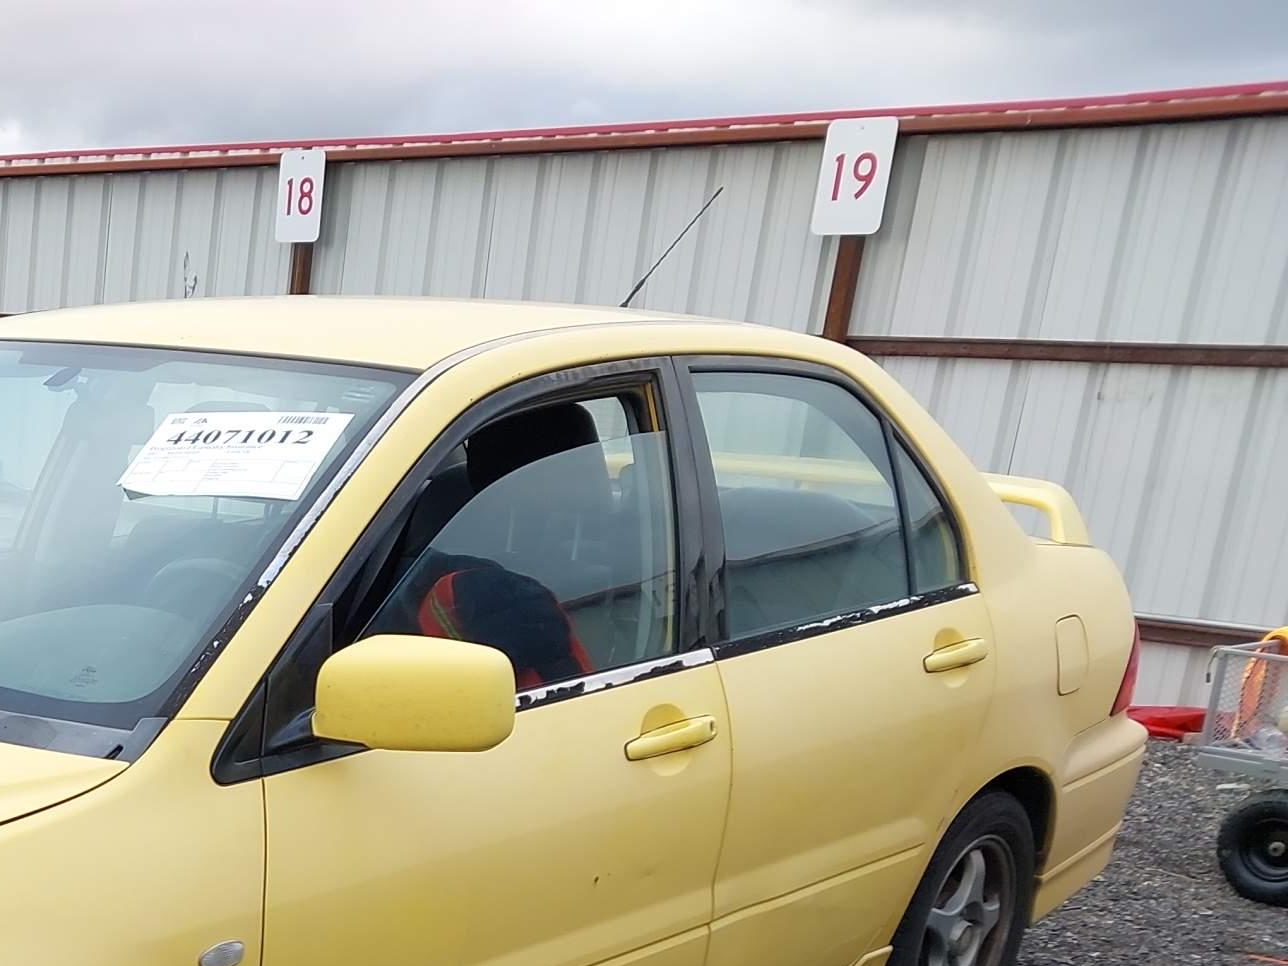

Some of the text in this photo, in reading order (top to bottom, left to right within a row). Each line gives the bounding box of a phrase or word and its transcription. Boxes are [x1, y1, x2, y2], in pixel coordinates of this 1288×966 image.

[286, 177, 314, 216] 18
[830, 152, 878, 202] 19
[166, 429, 314, 445] 44071012
